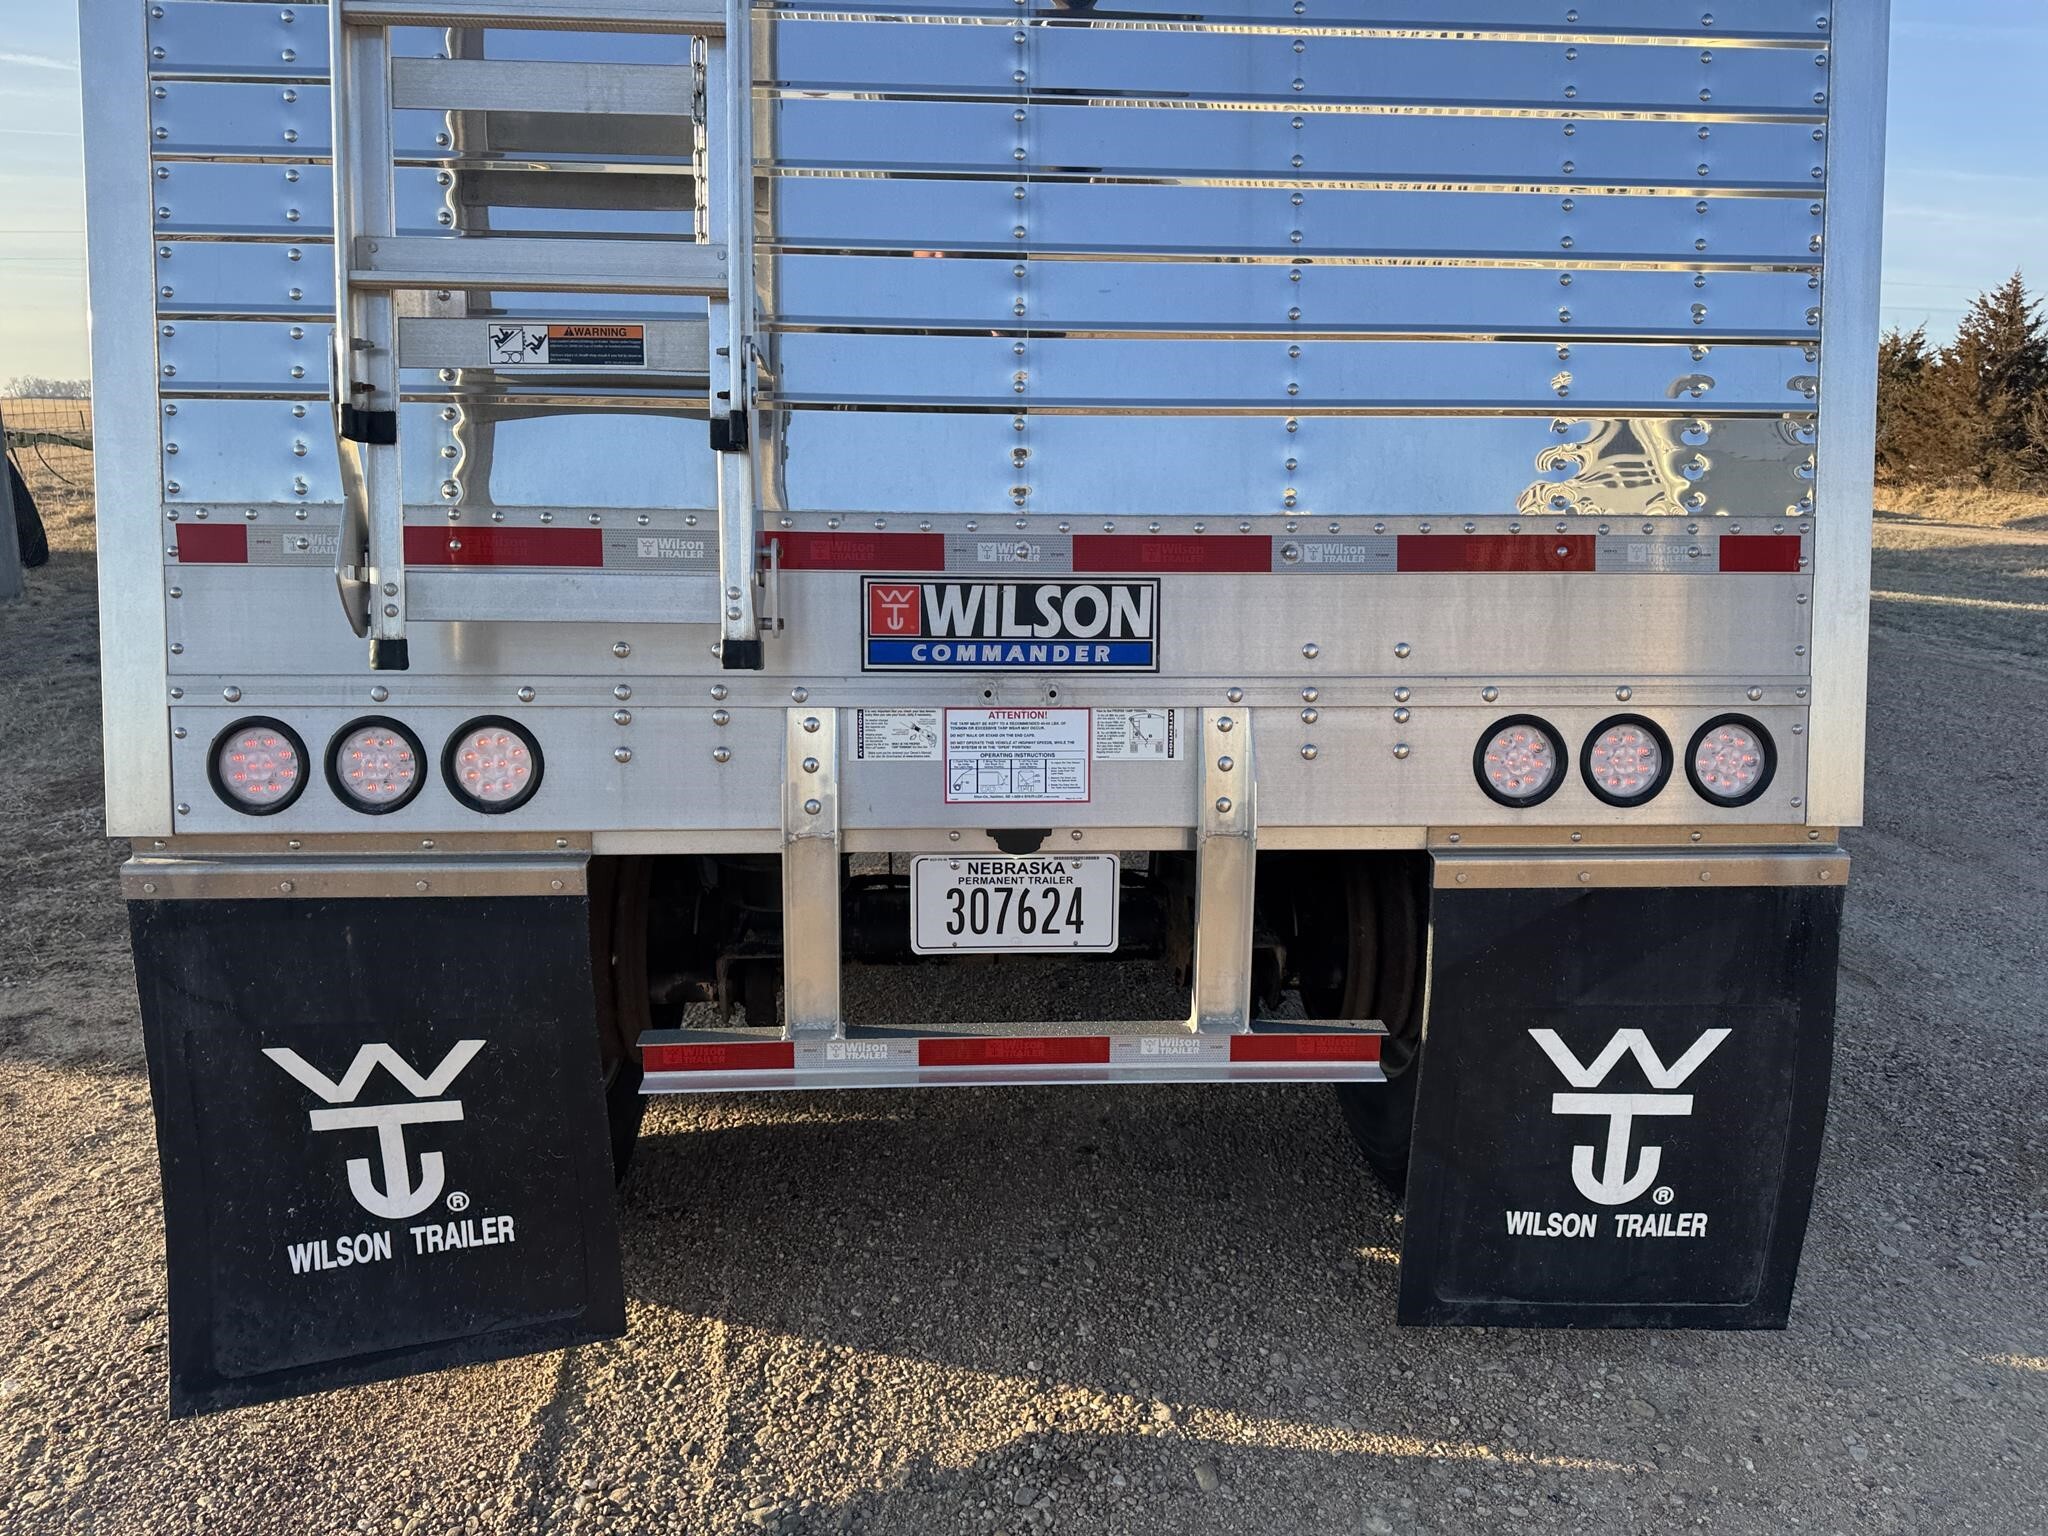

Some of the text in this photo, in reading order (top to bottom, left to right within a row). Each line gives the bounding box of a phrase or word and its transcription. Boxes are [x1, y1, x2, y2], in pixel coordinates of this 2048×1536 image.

[574, 328, 626, 336] WARNING
[658, 538, 704, 549] Wilson
[997, 543, 1040, 554] Win
[1323, 544, 1365, 554] Wilson
[924, 584, 1152, 638] WILSON
[912, 644, 1110, 662] COMMANDER
[988, 711, 1048, 719] ATTENTION!
[968, 862, 1066, 874] NEBRASKA
[958, 876, 1074, 885] PERMANENT TRAILER
[946, 886, 1084, 935] 307624
[846, 1042, 888, 1052] Wilson
[1160, 1038, 1200, 1047] Wilson
[1506, 1211, 1708, 1238] WILSON TRAILER
[287, 1215, 516, 1275] WILSON TRAILER
